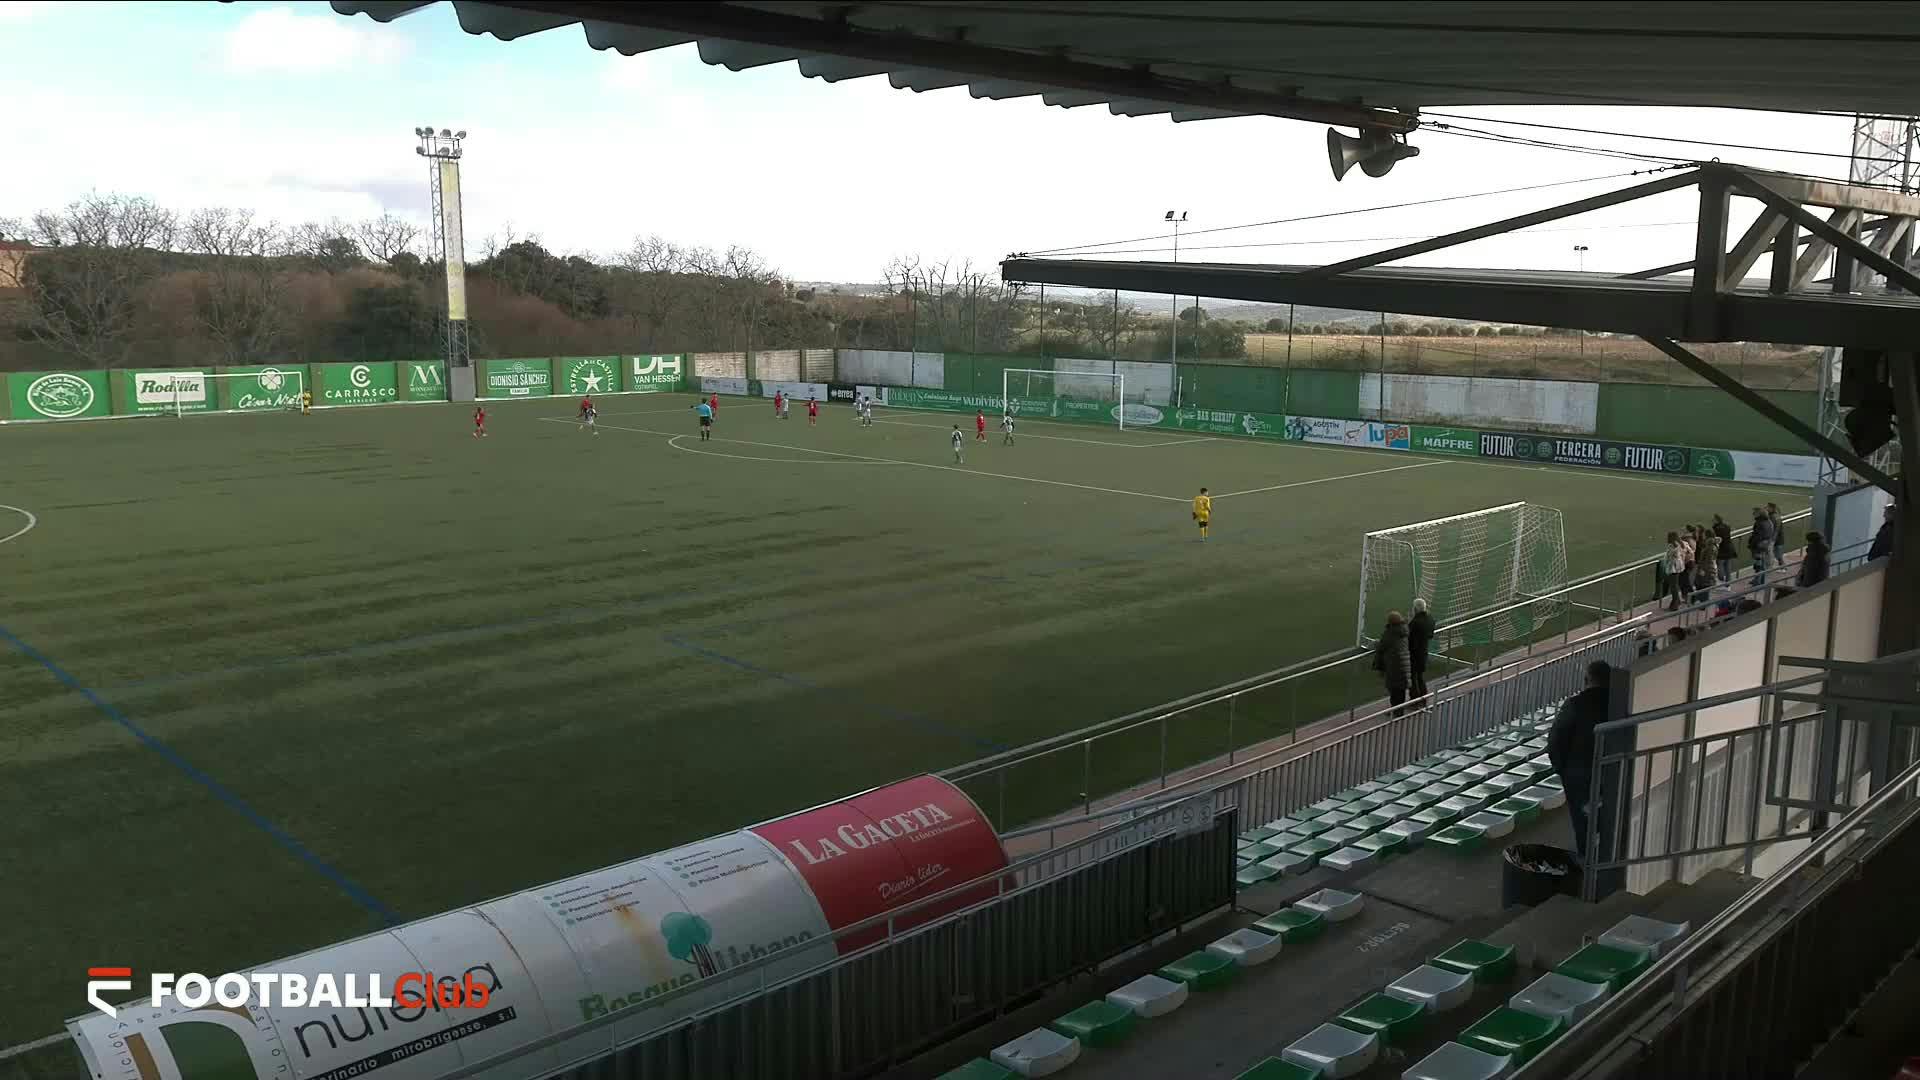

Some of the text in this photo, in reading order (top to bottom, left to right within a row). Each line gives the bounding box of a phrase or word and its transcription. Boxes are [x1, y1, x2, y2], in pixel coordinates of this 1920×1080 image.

[490, 374, 518, 387] DIONISIO
[634, 374, 680, 384] VAN HESSEN
[325, 387, 396, 399] CARRASCO
[1368, 423, 1409, 448] lupa
[1423, 437, 1473, 450] MAPFRE
[1555, 440, 1600, 459] TERCERA
[789, 838, 848, 866] LA
[838, 803, 954, 850] GACETA
